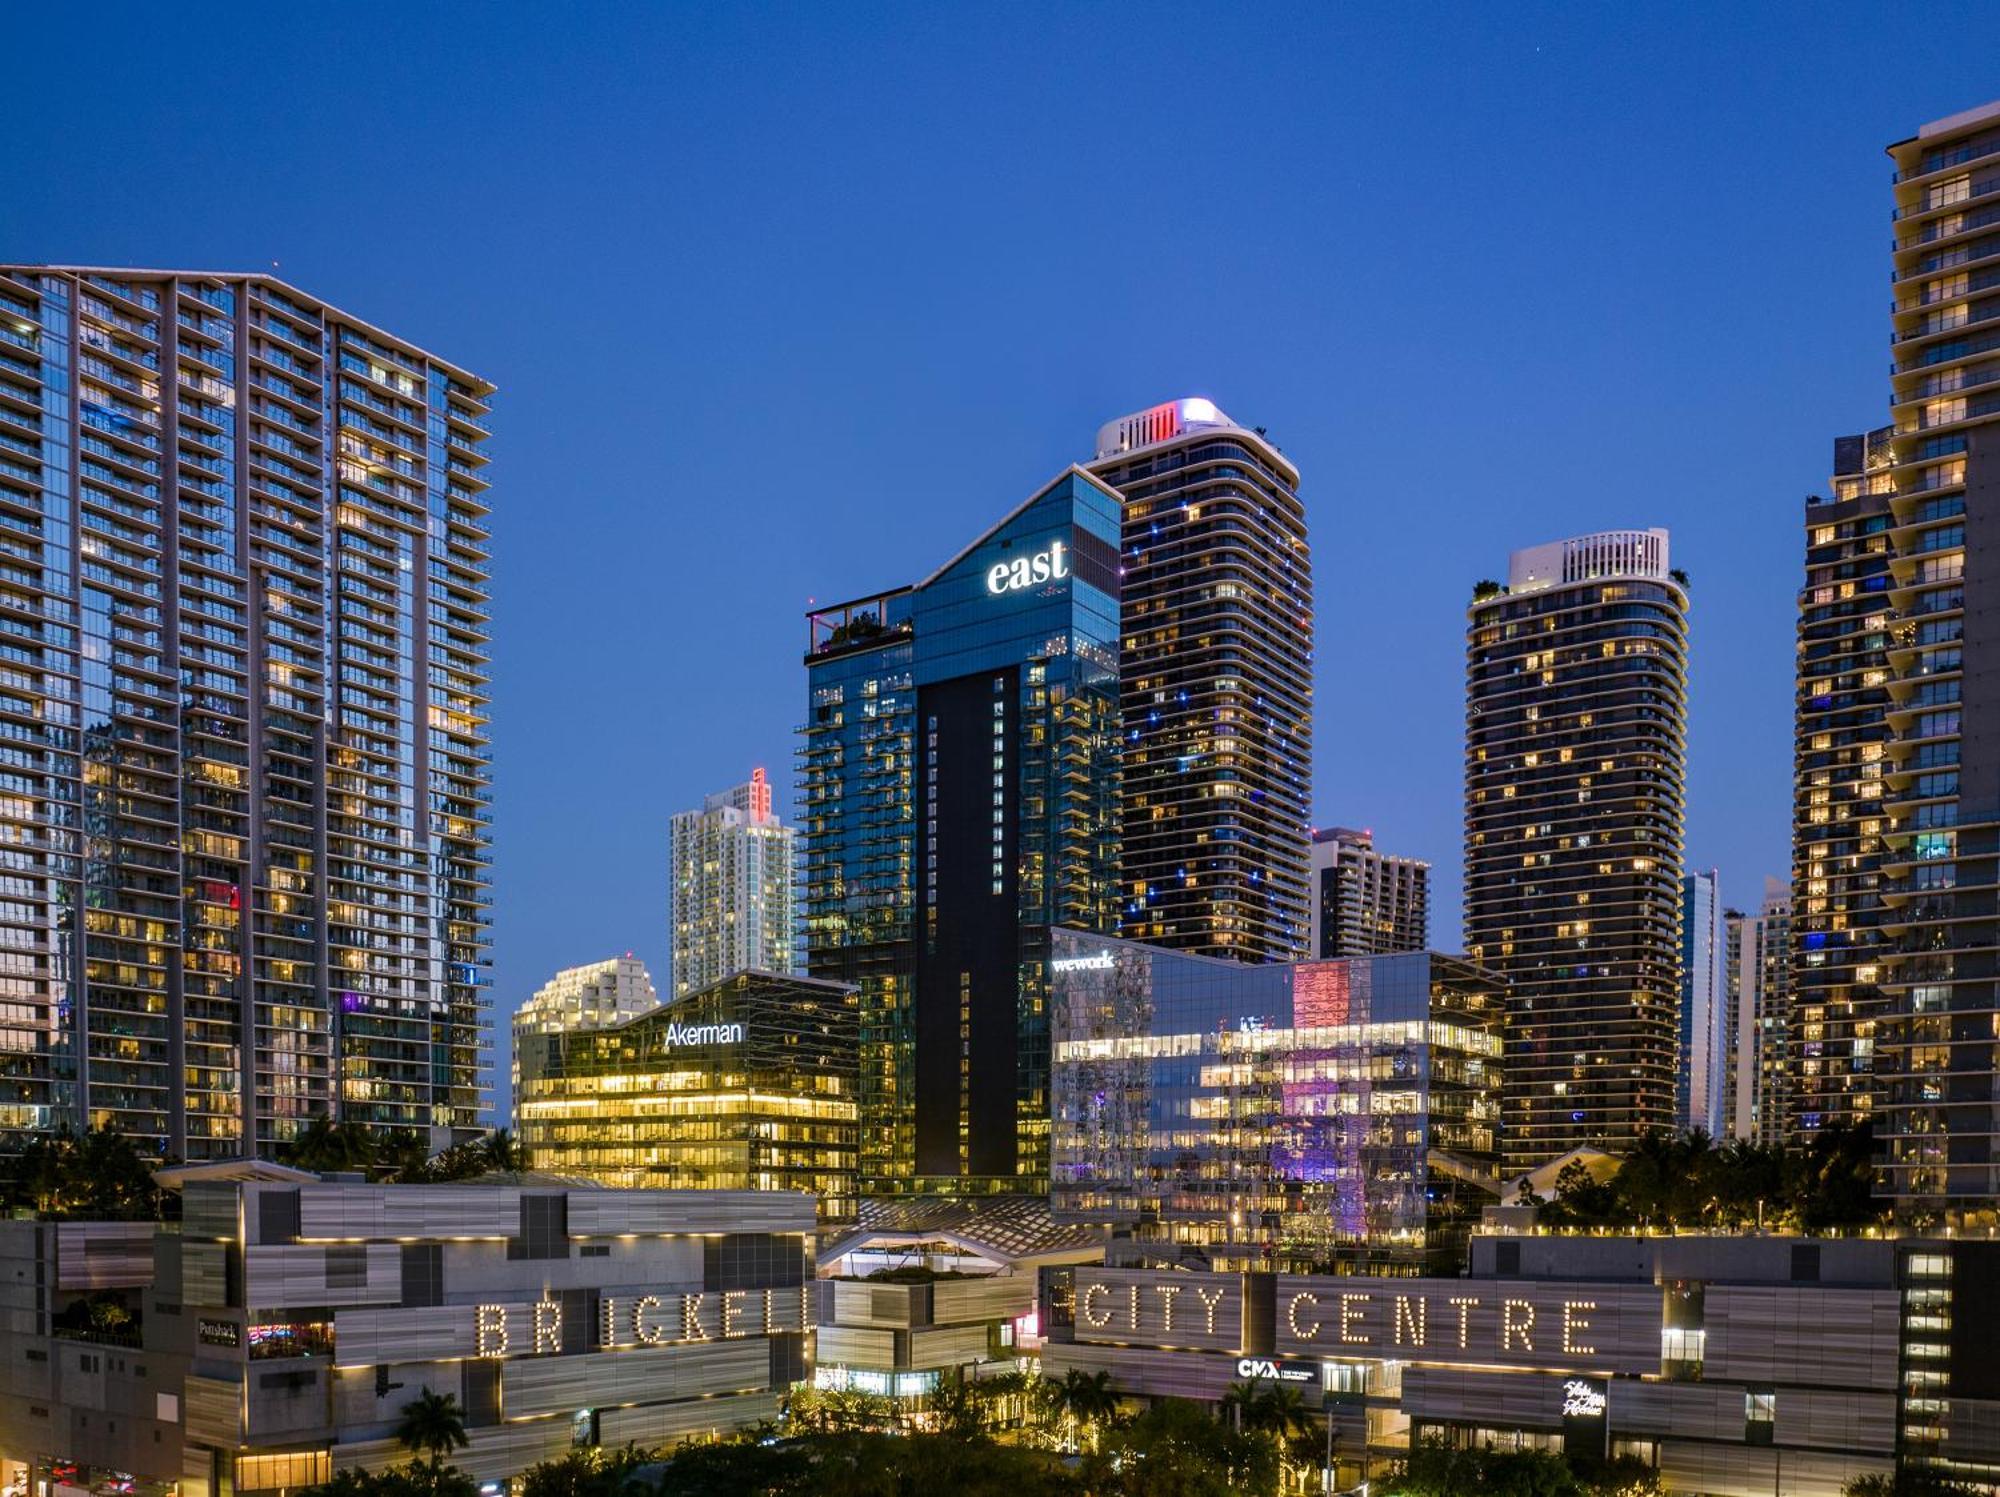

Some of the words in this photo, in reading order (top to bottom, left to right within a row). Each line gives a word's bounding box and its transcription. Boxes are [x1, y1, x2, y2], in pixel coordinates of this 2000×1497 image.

[988, 542, 1068, 594] east
[1052, 950, 1115, 972] wework
[664, 1023, 742, 1046] Akerman
[475, 1287, 817, 1358] BRICKELL
[1084, 1283, 1225, 1333] CITY
[1288, 1292, 1597, 1354] CENTRE
[1238, 1359, 1281, 1379] CMX
